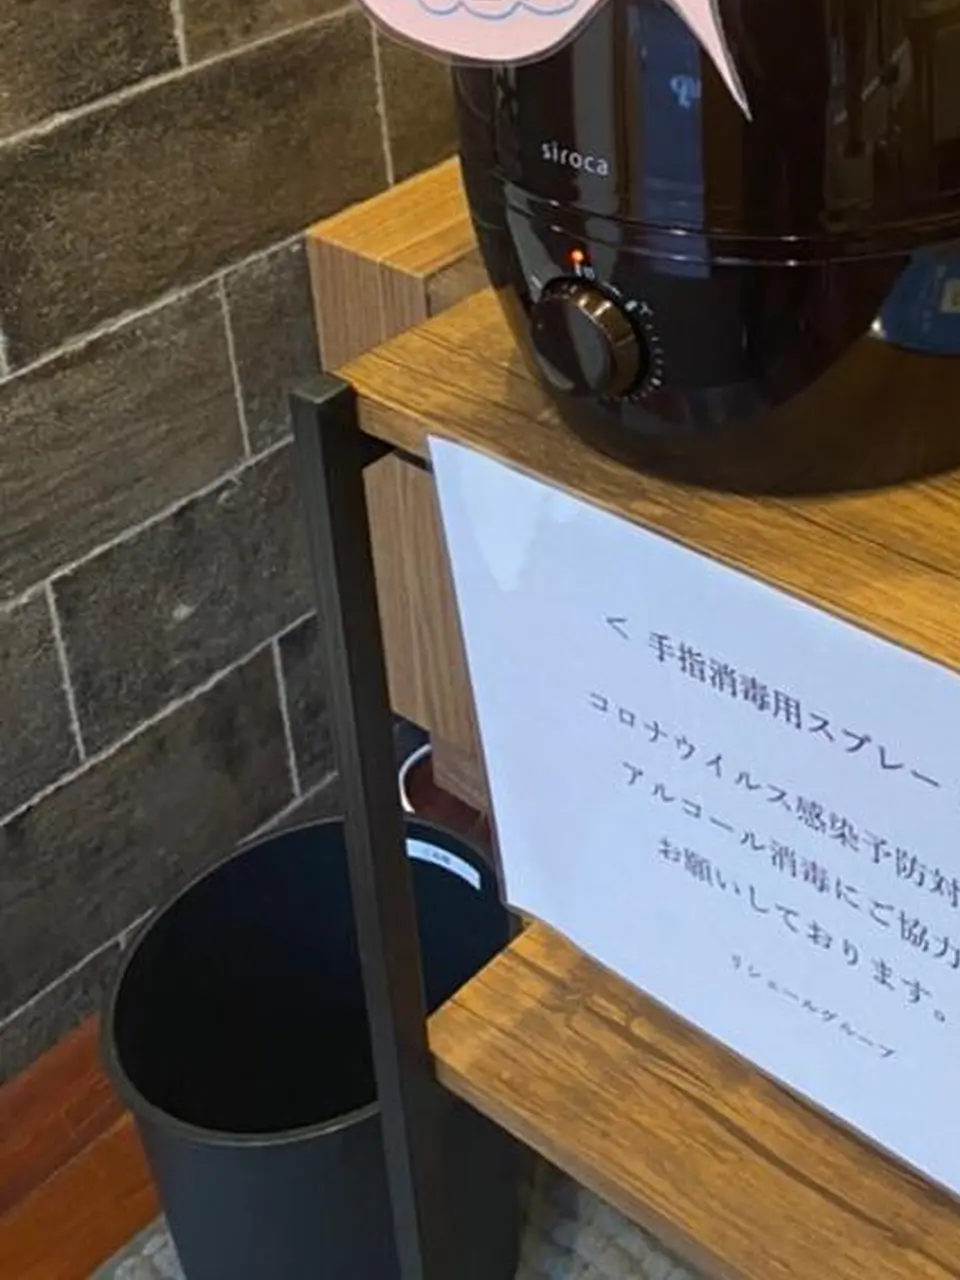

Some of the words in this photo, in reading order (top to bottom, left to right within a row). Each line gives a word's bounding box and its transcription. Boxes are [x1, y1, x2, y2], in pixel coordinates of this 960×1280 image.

[541, 140, 609, 176] siroca
[657, 837, 948, 1024] お願いしております。
